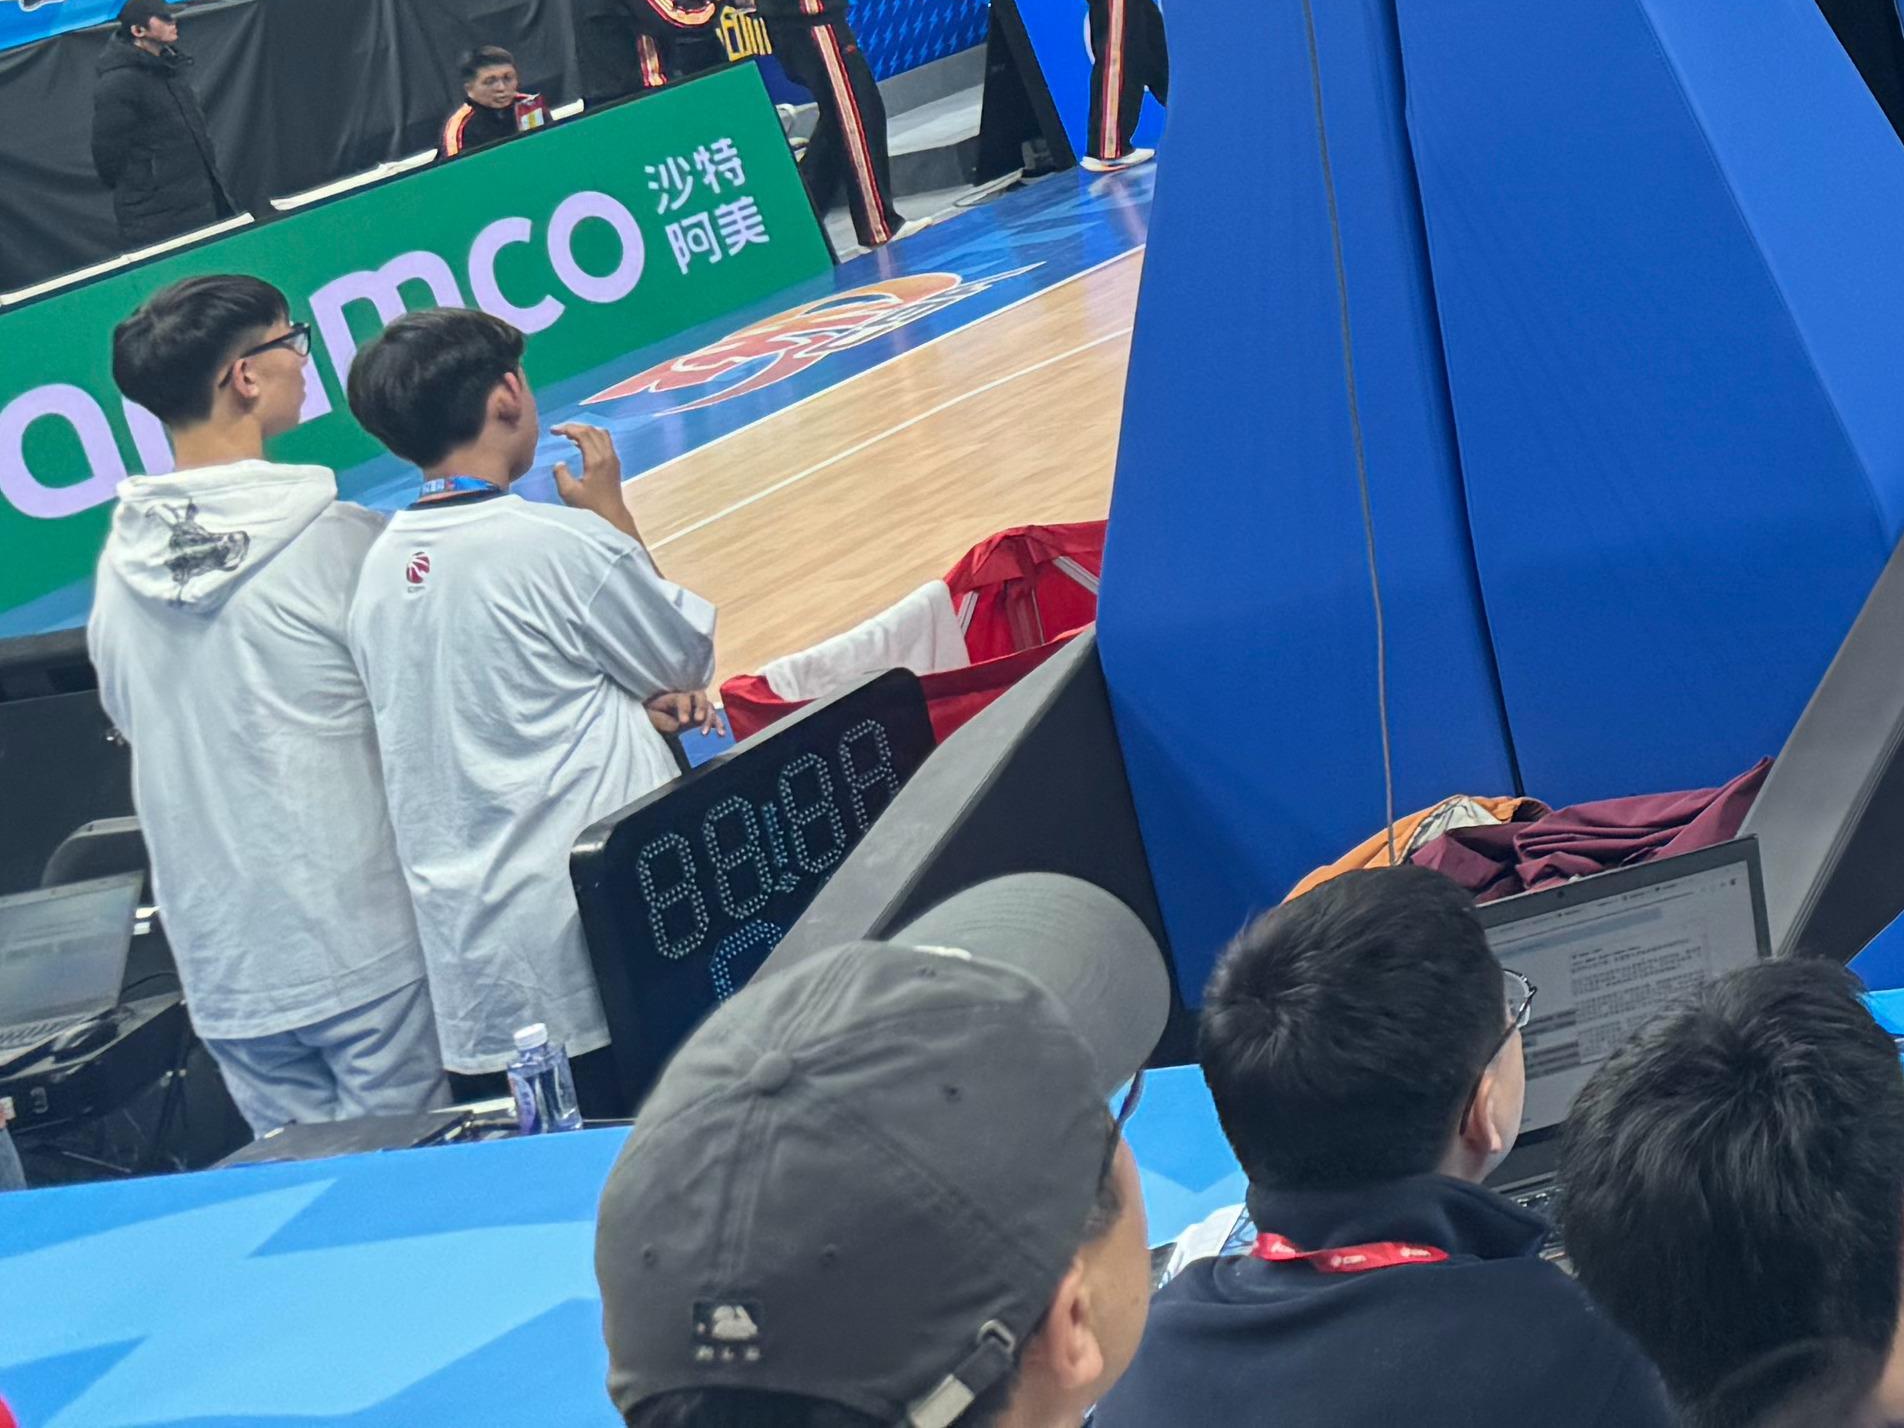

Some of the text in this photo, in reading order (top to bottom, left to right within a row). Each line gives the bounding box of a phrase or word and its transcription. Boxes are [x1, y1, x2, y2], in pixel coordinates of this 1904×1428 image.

[644, 134, 746, 214] 沙特
[665, 201, 771, 276] 阿美
[0, 190, 646, 522] amco
